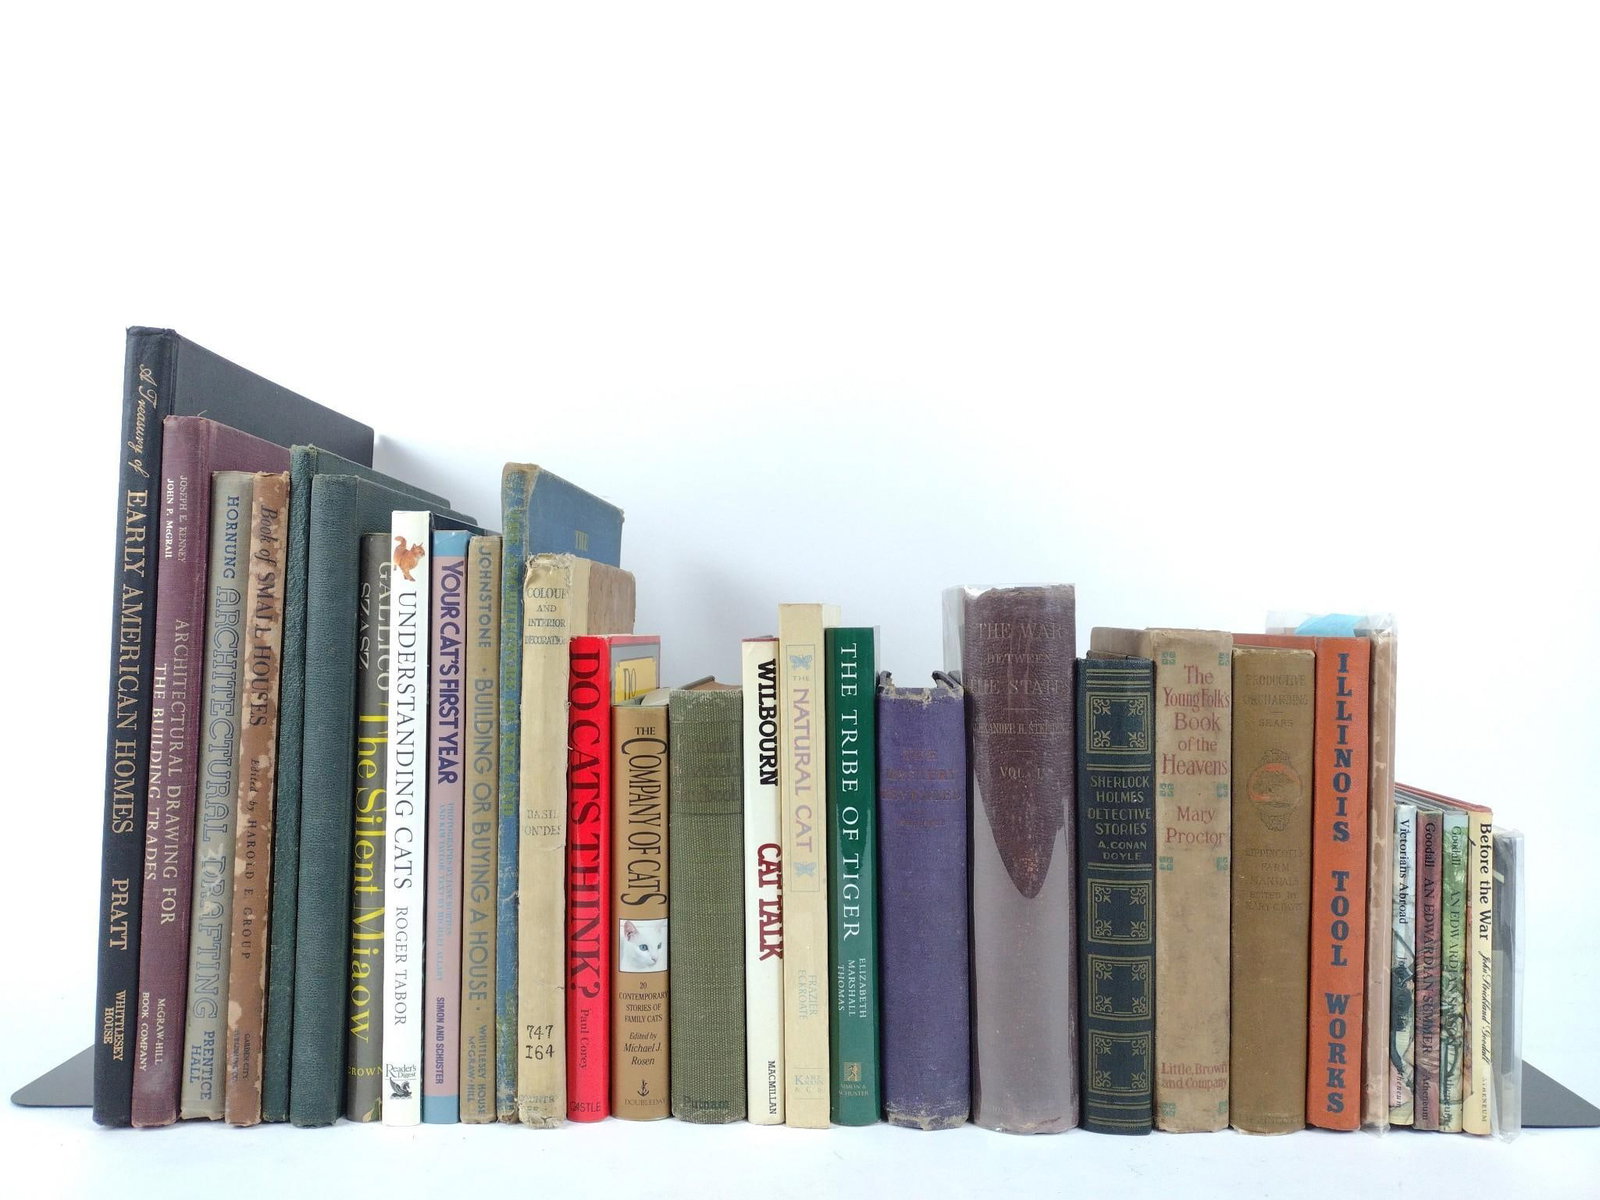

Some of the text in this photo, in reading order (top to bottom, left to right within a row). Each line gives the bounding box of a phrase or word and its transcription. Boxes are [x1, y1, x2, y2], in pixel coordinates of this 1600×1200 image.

[127, 364, 157, 478] A Treasury of
[163, 478, 174, 560] JOHN P. McGRAIL
[177, 475, 188, 563] JOSEPH KENNEY
[249, 505, 278, 727] Book of SMALL HOUSES
[528, 618, 566, 628] INTERIOR
[536, 604, 557, 613] AND
[979, 622, 1063, 639] THE WAR
[112, 489, 148, 834] EARLY AMERICAN HOMES
[438, 561, 464, 784] YOUR CAT'S FIRST YEAR
[968, 679, 1072, 695] THE STATES
[1184, 664, 1214, 684] The
[757, 658, 778, 786] WILBOURN
[1163, 687, 1230, 712] Young Folk's
[1174, 712, 1222, 731] Book
[193, 495, 241, 1019] HORNUNG ARCHITECTURAL DRAFTING
[635, 726, 656, 736] THE
[1178, 737, 1217, 752] of the
[1332, 653, 1353, 843] ILLINOIS
[145, 663, 167, 881] THE BUILDING TRADES
[160, 619, 189, 925] ARCHITECTURAL DRAWING FOR
[468, 546, 493, 1001] JOHNSTONE BUILDING OR BUYING A HOUSE
[793, 688, 812, 853] NATURAL CAT
[840, 643, 860, 941] THE TRIBE OF TIGER
[1091, 776, 1149, 788] SHERLOCK
[1162, 754, 1228, 776] Heavens
[393, 592, 416, 1025] UNDERSTANDING CATS ROGER TABOR
[527, 808, 559, 819] BASIL
[569, 649, 602, 999] DO CATS THINK?
[620, 737, 668, 906] COMPANY OF CATS
[1088, 808, 1151, 820] DETECTIVE
[1096, 791, 1144, 803] HOLMES
[1177, 806, 1216, 824] Mary
[1095, 823, 1147, 835] STORIES
[1103, 852, 1142, 861] DOYLE
[1165, 828, 1226, 846] Proctor
[242, 760, 259, 960] Edited by HAROLD GROUP
[350, 703, 388, 1043] The Silent Miaow
[1399, 819, 1410, 925] Victorians Abroad
[1480, 823, 1492, 941] Before the War
[109, 878, 130, 950] PRATT
[757, 843, 783, 961] CAT TALK
[1331, 870, 1350, 967] TOOL
[1449, 826, 1461, 993] Goodall AN EDWARDIAN
[1422, 822, 1436, 1057] Goodall AN EDWARDIAN SUMMER
[1479, 950, 1491, 976] John
[619, 991, 668, 1001] CONTEMPORARY
[626, 1003, 661, 1012] STORIES OF
[639, 981, 648, 990] 20
[808, 974, 819, 1016] FRAZIER
[848, 959, 856, 1016] MARSHALL
[859, 958, 867, 1018] ELIZABETH
[103, 1007, 115, 1044] HOUSE
[113, 990, 127, 1062] WHITTLESEY
[139, 992, 150, 1072] BOOK COMPANY
[154, 998, 165, 1065] McGRAW-HILL
[435, 997, 445, 1084] SIMON AND SCHUSTER
[526, 1025, 554, 1041] 747
[579, 1008, 591, 1069] Paul Corey
[624, 1014, 663, 1023] FAMILY CATS
[629, 1032, 657, 1041] Edited by
[1481, 1027, 1490, 1065] Goodall
[189, 1044, 202, 1084] HALL
[200, 1030, 216, 1100] PRENTICE
[385, 1063, 417, 1078] Reader's
[397, 1071, 416, 1079] Digest
[477, 1025, 487, 1115] WHITTLESEY HOUSE
[624, 1043, 663, 1053] Michael J.
[631, 1056, 655, 1066] Rosen
[1195, 1062, 1227, 1074] Brown
[1325, 992, 1350, 1114] WORKS
[767, 1060, 777, 1115] MACMILLAN
[1162, 1077, 1227, 1091] and Company
[1422, 1076, 1431, 1121] Atheneum
